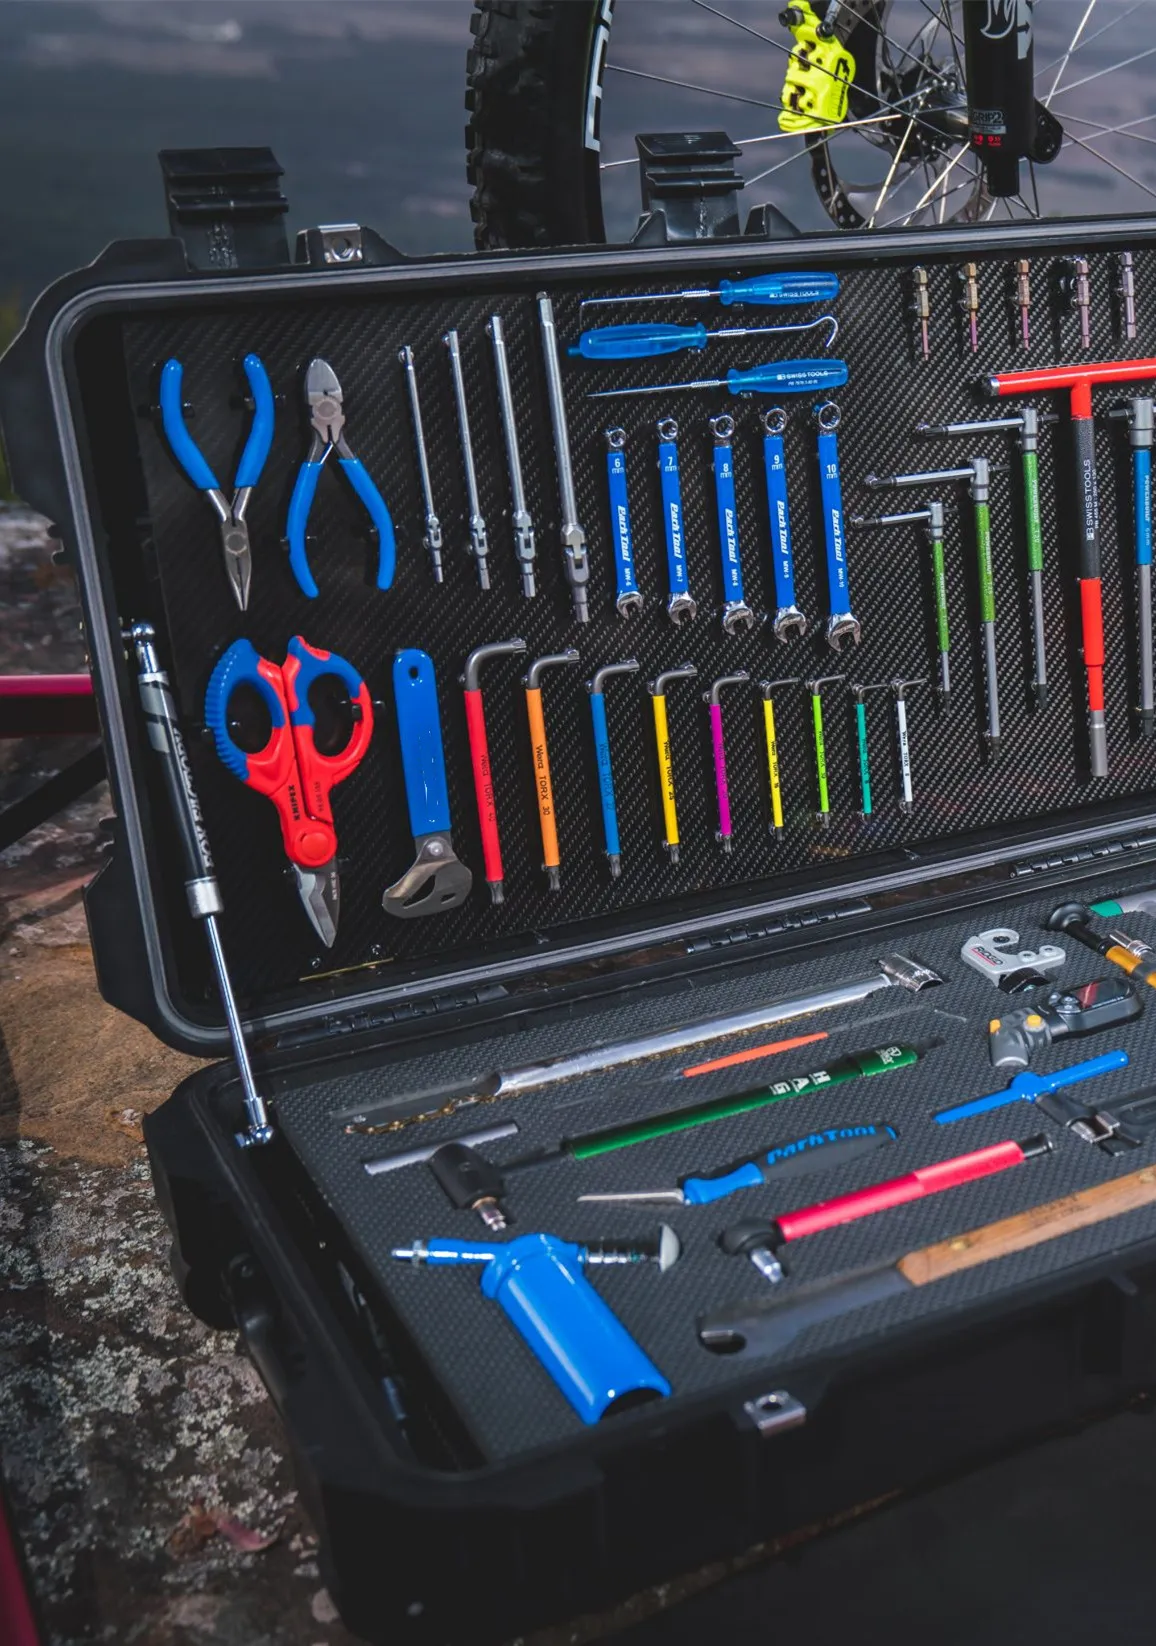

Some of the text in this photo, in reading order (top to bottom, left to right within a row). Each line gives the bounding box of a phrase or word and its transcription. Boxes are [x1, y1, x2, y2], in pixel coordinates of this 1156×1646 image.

[614, 458, 620, 467] 6
[668, 456, 673, 466] 7
[723, 463, 728, 472] 8
[774, 455, 779, 464] 9
[827, 464, 836, 473] 10
[1084, 459, 1092, 493] TOOLS
[1085, 495, 1094, 526] SWISS
[536, 745, 544, 769] Wera
[602, 773, 614, 797] TORX
[666, 766, 674, 786] TORX
[484, 784, 494, 807] TORX
[539, 776, 548, 800] TORX
[289, 785, 301, 821] KNIPEX
